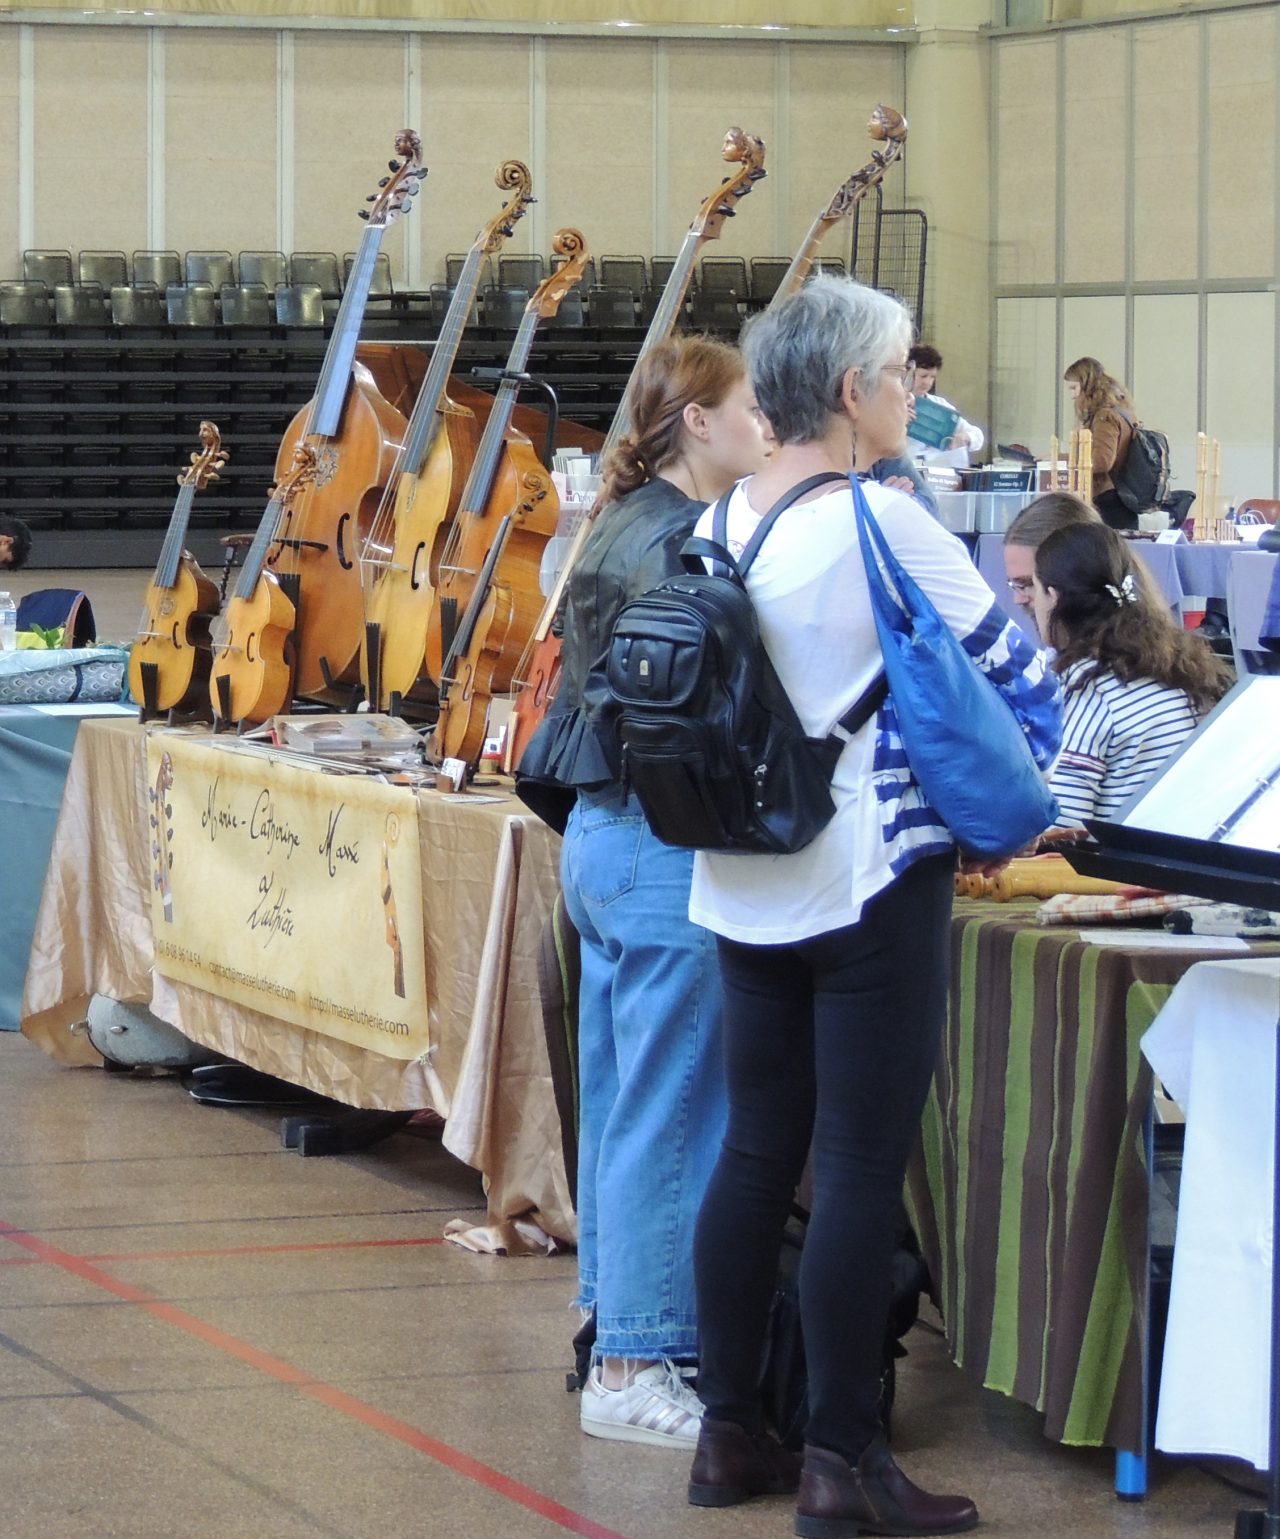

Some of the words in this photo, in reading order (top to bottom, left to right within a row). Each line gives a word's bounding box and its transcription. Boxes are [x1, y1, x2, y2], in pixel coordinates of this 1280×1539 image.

[201, 776, 300, 860] Marie-Catherine
[318, 803, 360, 878] Massé
[246, 871, 295, 949] Luthière
[308, 992, 409, 1036] http://masselutherie.com
